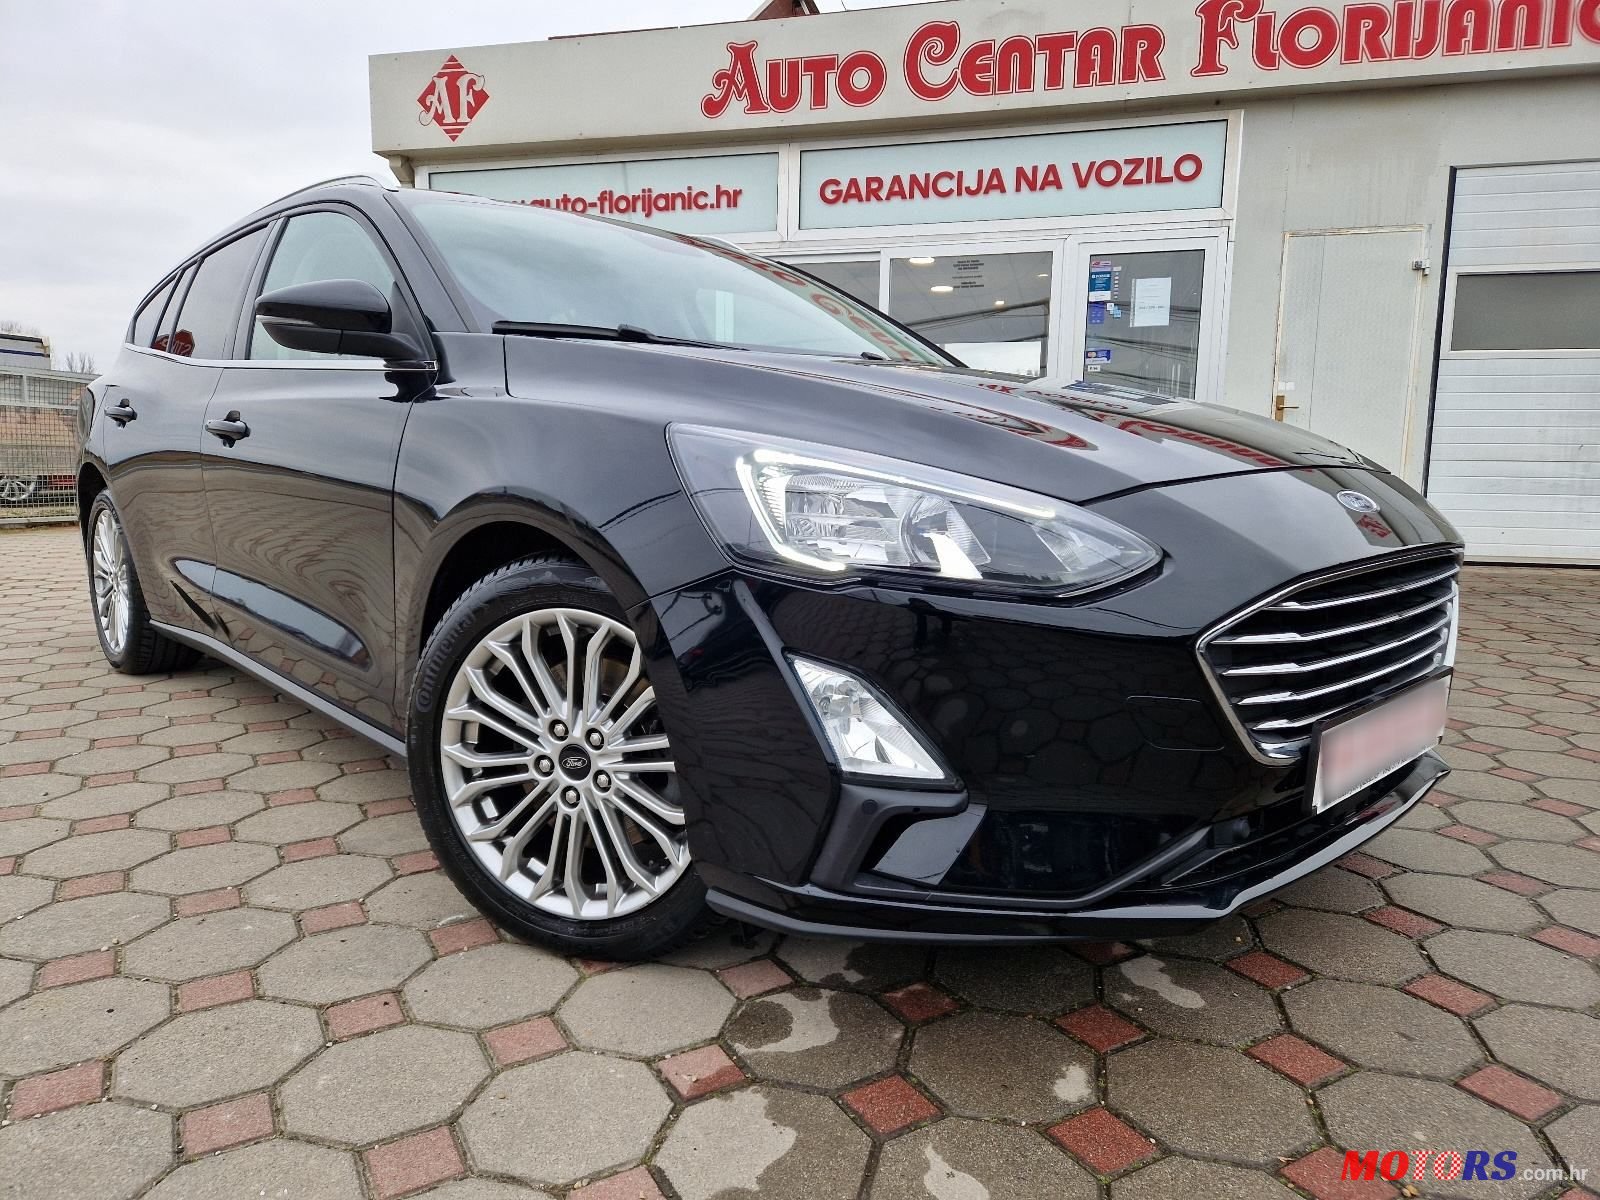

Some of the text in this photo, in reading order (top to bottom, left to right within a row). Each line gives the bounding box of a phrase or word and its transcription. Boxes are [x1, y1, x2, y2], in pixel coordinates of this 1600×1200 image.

[701, 39, 888, 119] AUTO
[902, 20, 1166, 102] CENTAR
[512, 186, 742, 218] auto-florijanic.hr
[819, 153, 1203, 206] GARANCIJA NA VOZILO
